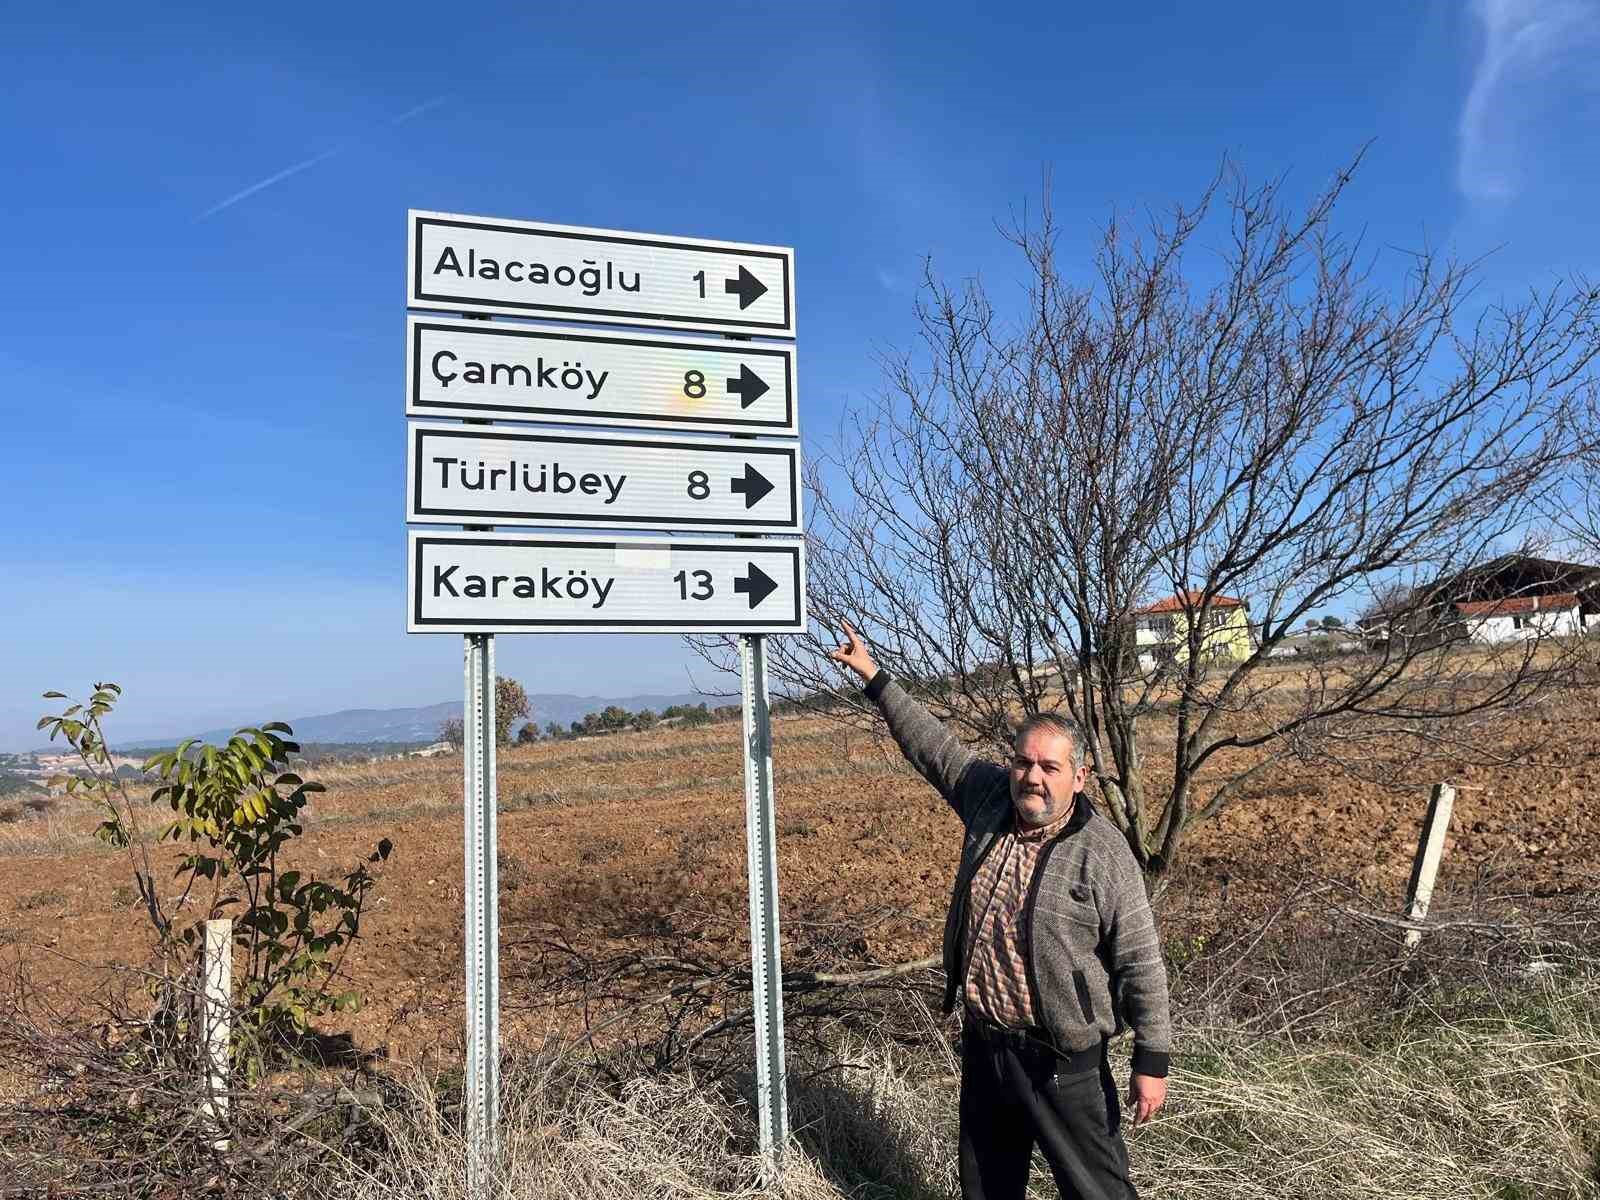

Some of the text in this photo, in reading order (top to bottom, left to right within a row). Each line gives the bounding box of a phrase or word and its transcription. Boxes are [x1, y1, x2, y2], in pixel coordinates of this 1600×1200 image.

[433, 246, 706, 299] Alacaoğlu 1
[432, 351, 706, 399] Çamköy 8
[433, 458, 710, 504] Türlübey 8
[434, 566, 713, 608] Karaköy 13
